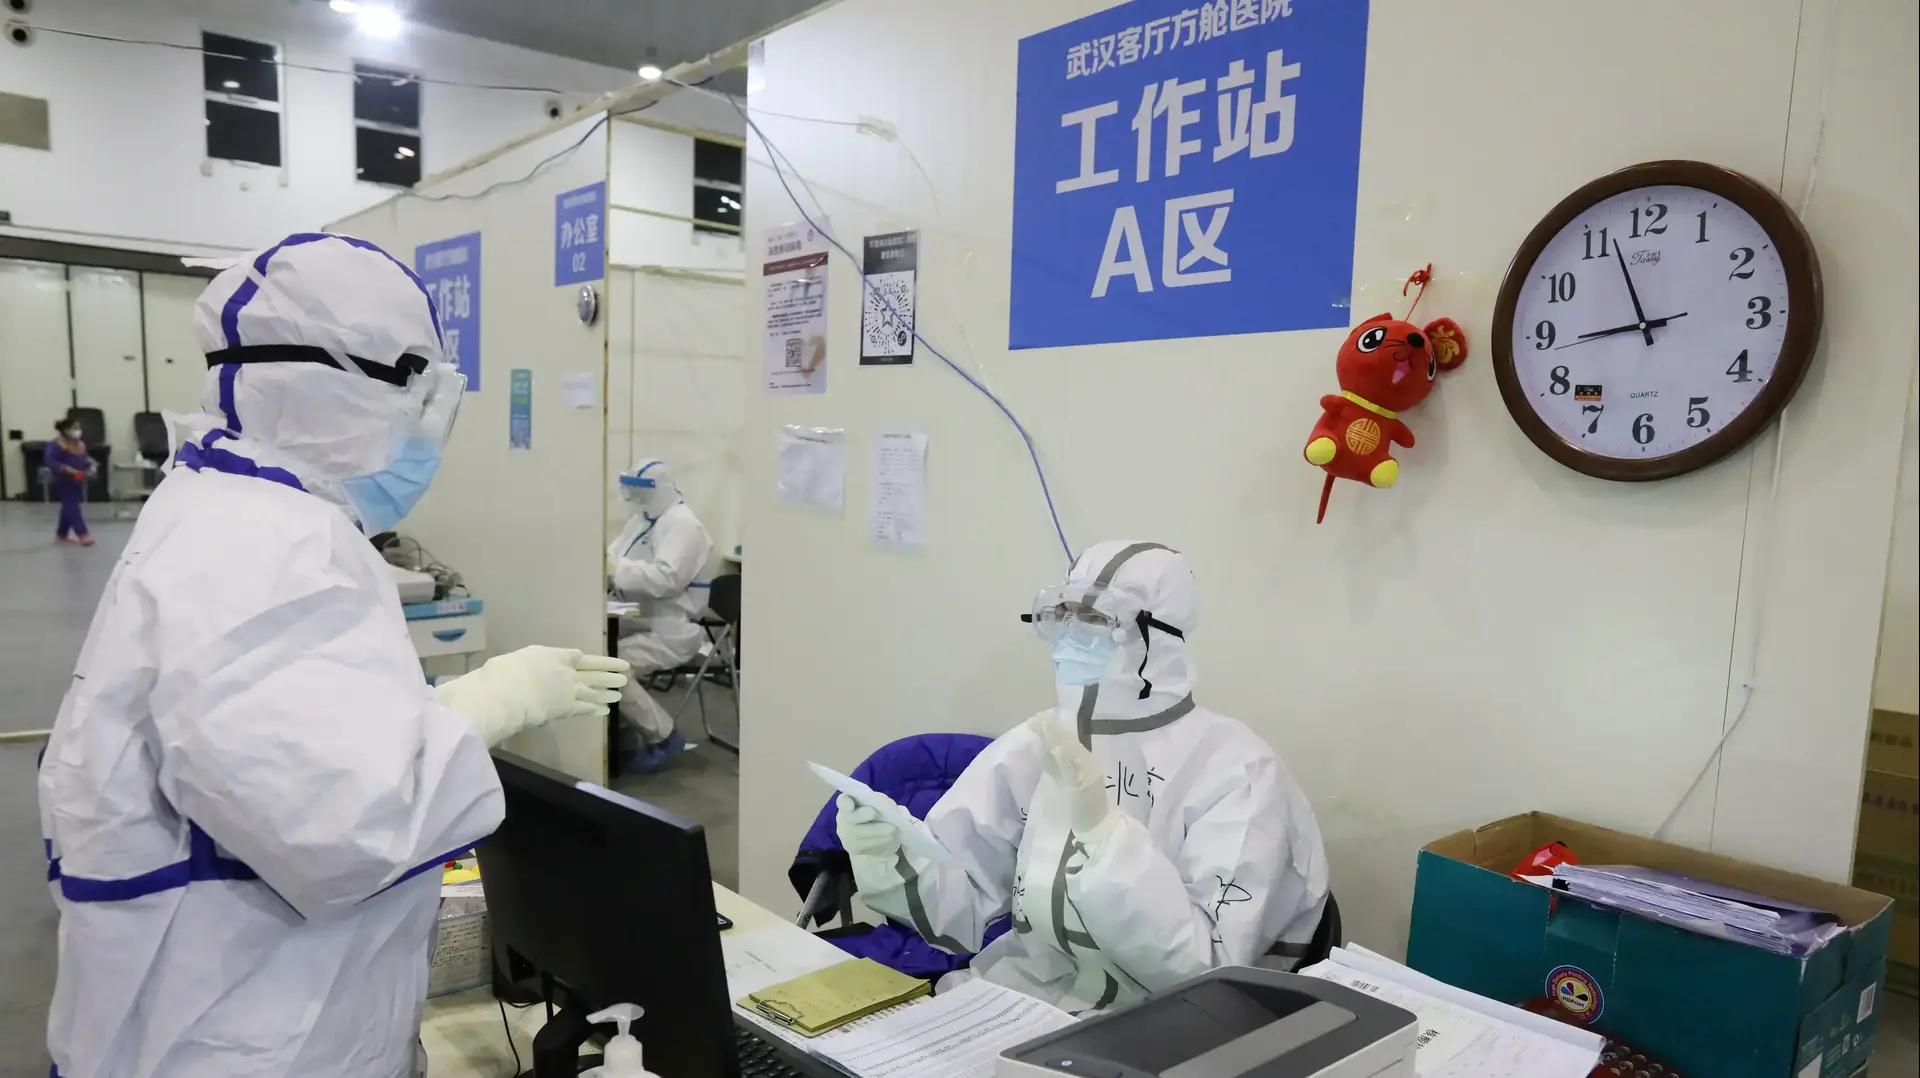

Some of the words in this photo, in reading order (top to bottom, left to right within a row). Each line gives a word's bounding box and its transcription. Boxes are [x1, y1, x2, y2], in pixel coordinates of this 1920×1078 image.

[1066, 0, 1293, 80] 武汉客厅方舱医院
[1055, 48, 1301, 195] 工作站
[560, 213, 599, 249] 办公室
[1628, 203, 1668, 239] 12
[1694, 210, 1710, 244] 1
[1090, 188, 1235, 299] A区
[1581, 227, 1611, 261] 11
[572, 251, 586, 273] 02
[1728, 246, 1755, 282] 2
[1547, 271, 1576, 304] 10
[1745, 295, 1772, 330] 3
[1534, 320, 1557, 351] 9
[1549, 365, 1571, 396] 8
[1725, 349, 1753, 383] 4
[1630, 390, 1659, 399] QUARTZ
[1581, 404, 1604, 434] 7
[1631, 413, 1656, 445] 6
[1686, 396, 1711, 428] 5
